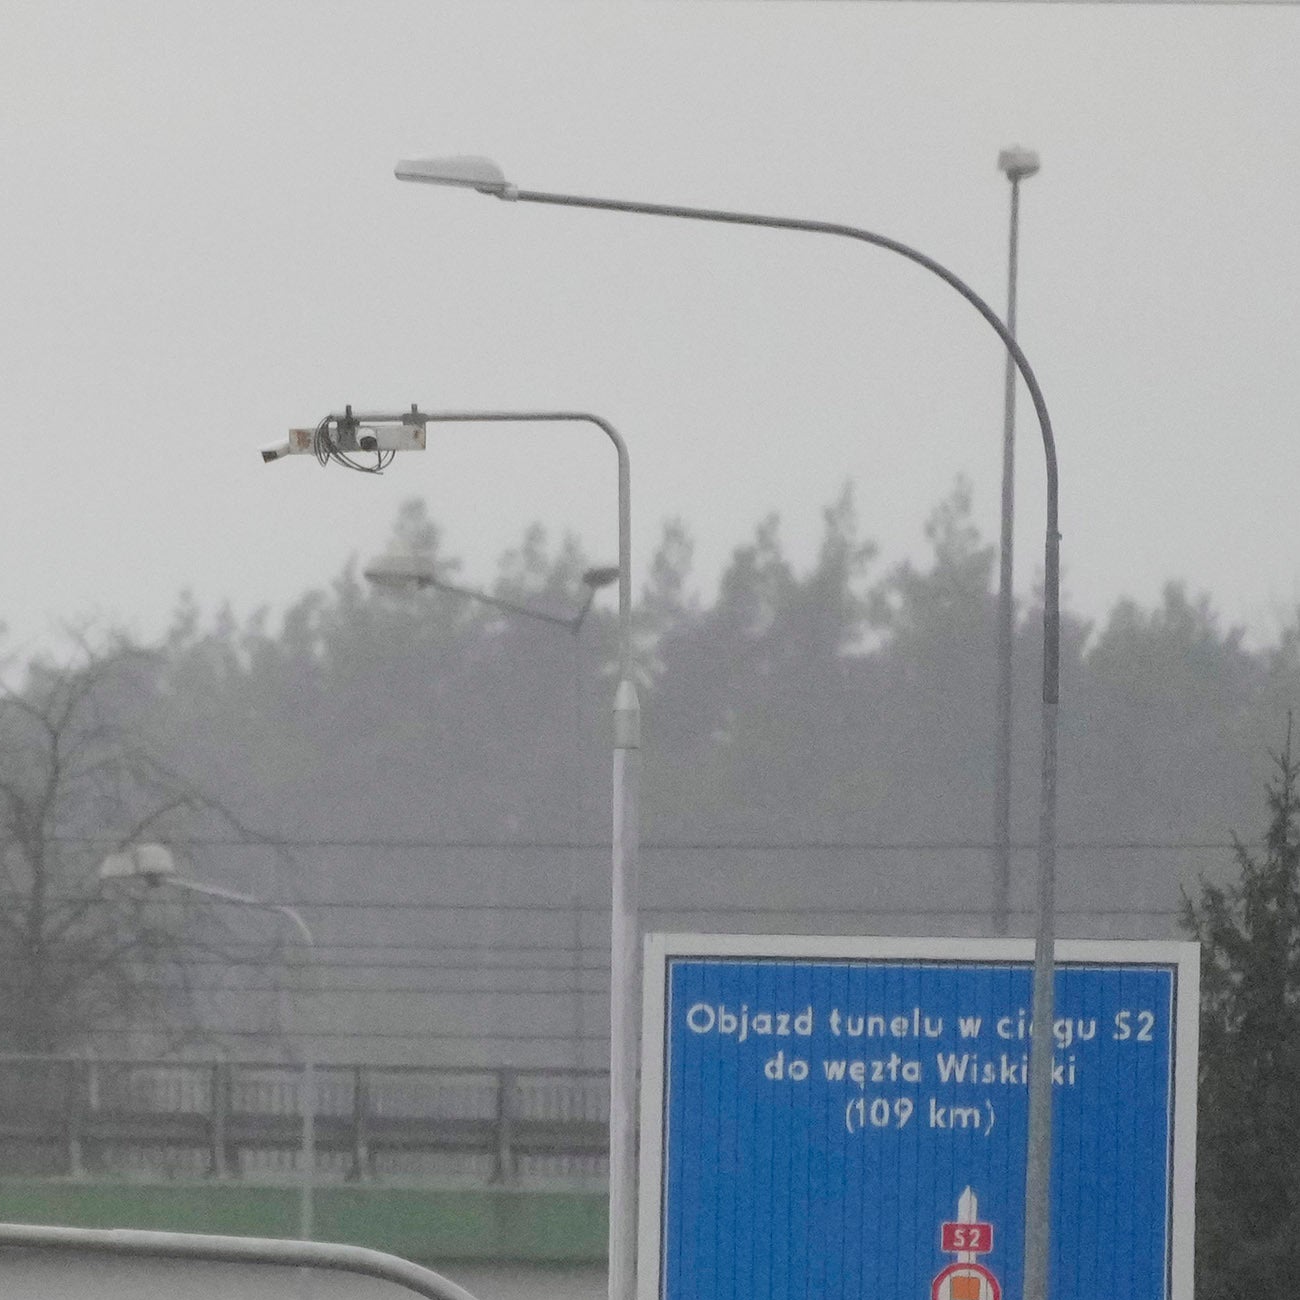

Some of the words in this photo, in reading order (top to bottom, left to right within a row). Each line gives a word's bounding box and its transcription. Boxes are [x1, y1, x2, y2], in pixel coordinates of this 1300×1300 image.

[686, 1003, 813, 1044] Objazd
[829, 1007, 943, 1038] tunelu
[959, 1016, 983, 1039] w
[996, 1008, 1097, 1049] cigu
[1112, 1009, 1155, 1042] S2
[764, 1050, 809, 1082] do
[823, 1052, 923, 1091] węzła
[936, 1052, 1077, 1086] Wiskiki
[845, 1097, 914, 1134] (109
[929, 1097, 996, 1137] km)
[953, 1228, 981, 1248] S2
